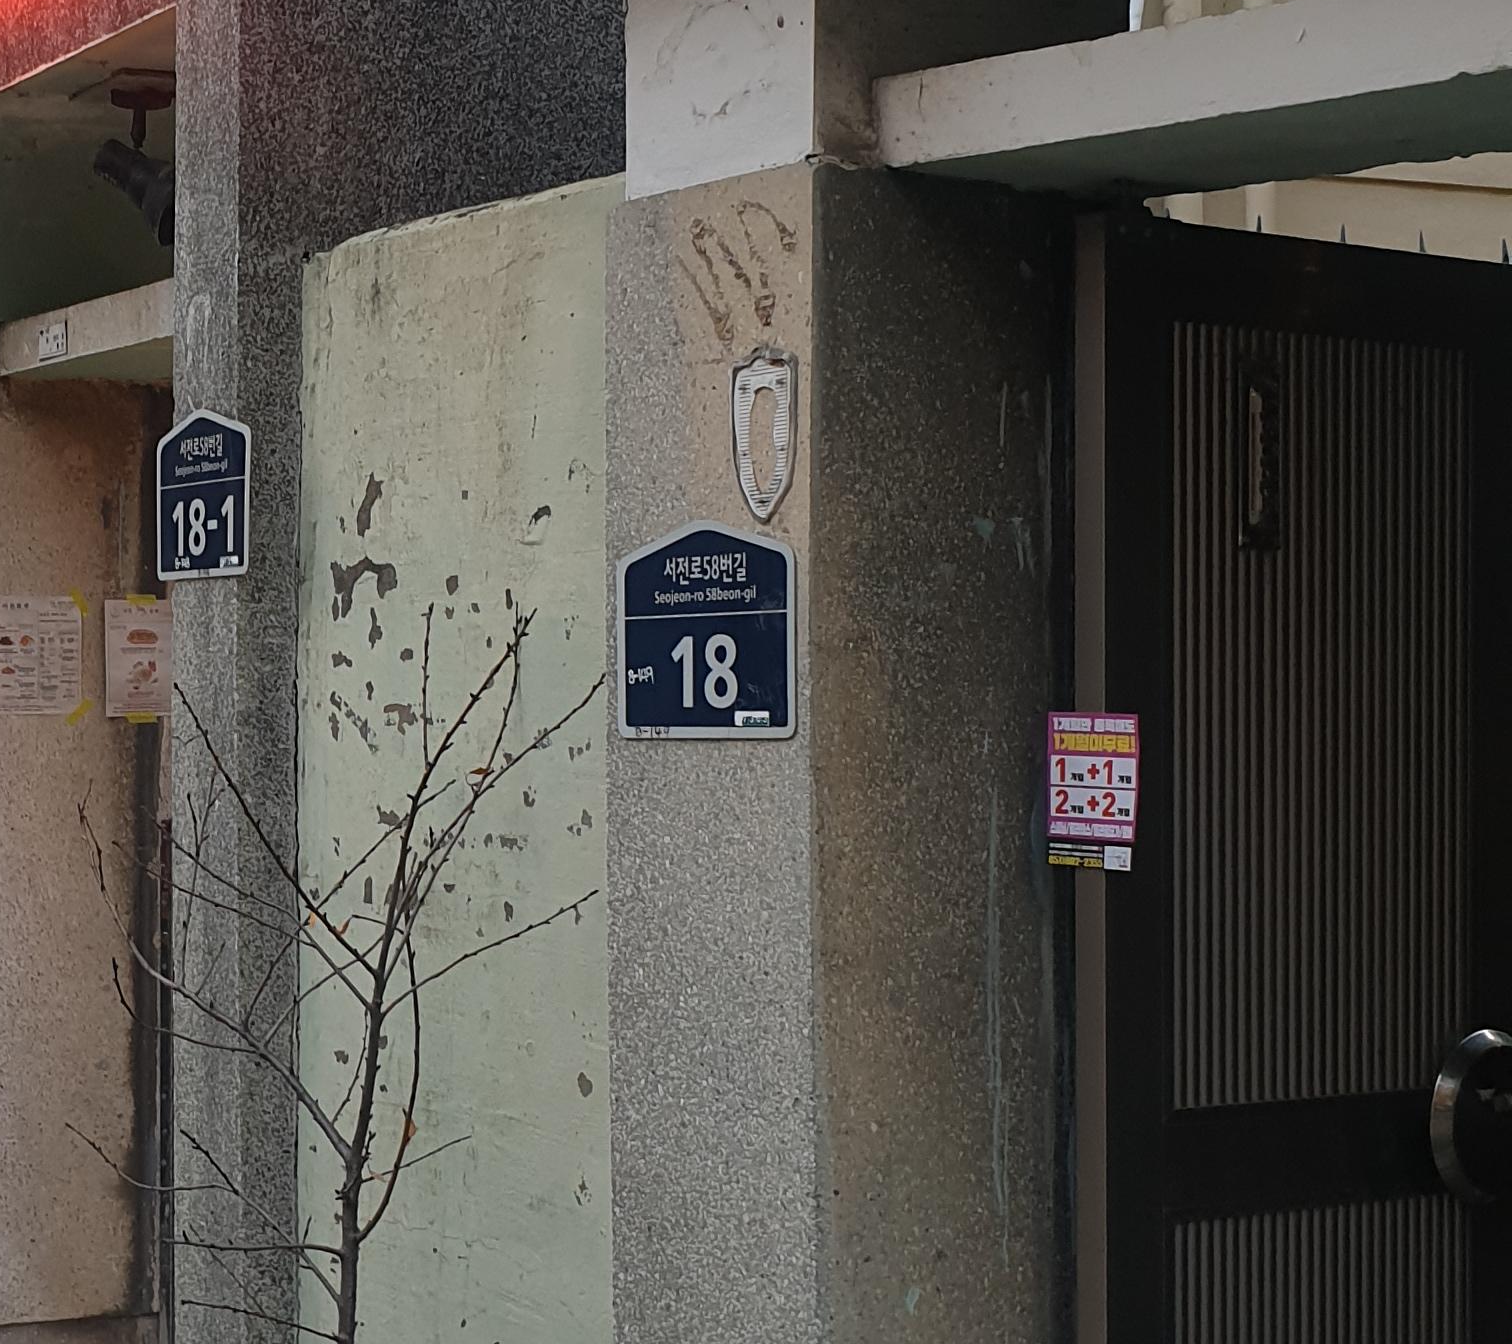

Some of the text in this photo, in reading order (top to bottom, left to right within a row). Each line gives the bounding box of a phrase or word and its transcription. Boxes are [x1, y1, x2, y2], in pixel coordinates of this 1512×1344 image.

[172, 494, 234, 557] 18-1
[663, 551, 747, 586] 서전로58번길
[654, 585, 757, 607] Seojeon-ro 58beon-gil
[670, 633, 739, 710] 18
